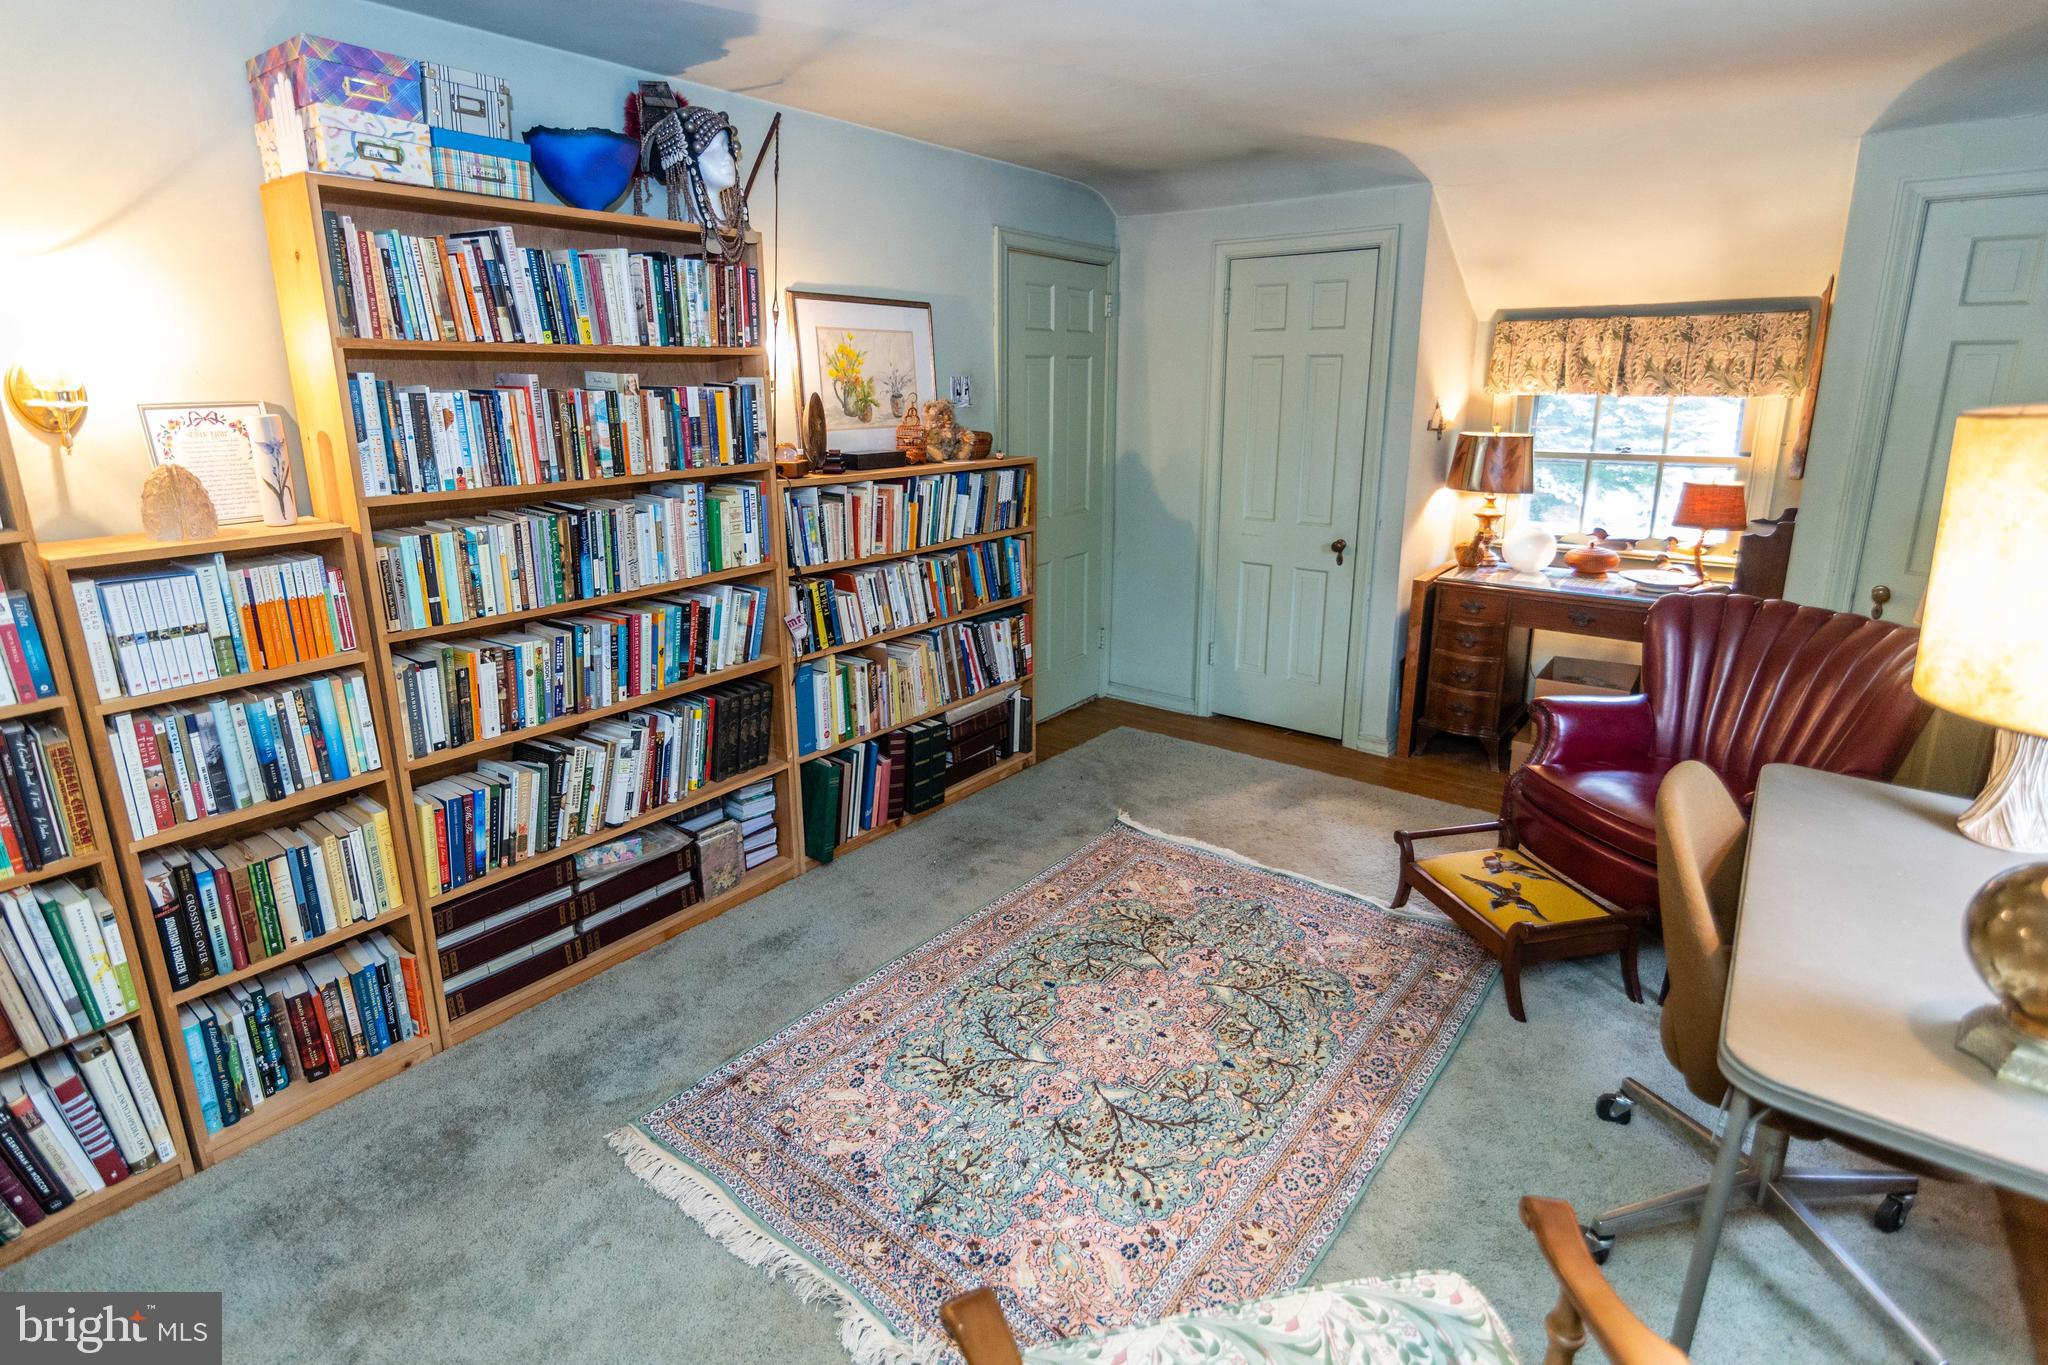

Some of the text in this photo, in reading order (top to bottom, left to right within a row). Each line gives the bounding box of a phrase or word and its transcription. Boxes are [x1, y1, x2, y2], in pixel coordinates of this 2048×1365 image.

[330, 219, 344, 281] DEAREST FRIEND
[504, 230, 518, 265] GEISHA,
[514, 275, 524, 294] LIFE
[529, 250, 539, 284] SHUTTERBABE
[362, 381, 378, 427] LOUISE
[631, 399, 640, 431] Benjamin
[359, 449, 367, 470] PAMELA
[487, 438, 495, 465] SONGLINES
[686, 488, 697, 527] 1861
[551, 531, 559, 550] Capture
[579, 516, 590, 554] Dreaming Water
[203, 572, 217, 596] JAMES
[396, 577, 406, 600] SOLOMON
[474, 580, 482, 606] PATCHETT
[13, 599, 30, 628] Tisha
[976, 627, 986, 654] HUMANS
[407, 677, 419, 720] ORCHARDIST
[137, 735, 149, 763] TRUTH
[146, 736, 157, 760] PLAIN
[171, 733, 180, 753] CRACE
[259, 723, 273, 758] MOUNTAIN
[177, 758, 185, 775] BEING
[56, 745, 93, 845] MICHAEL CHABON
[152, 793, 163, 818] PICOULT
[254, 864, 262, 881] Barbara
[185, 892, 209, 964] CROSSING OVER
[213, 924, 227, 957] SUSAN STRAIGHT
[164, 916, 186, 974] JONATHAN FRANZEN
[256, 995, 267, 1021] Celeste Ng
[322, 990, 335, 1018] HAMILTON
[329, 990, 336, 999] MY
[382, 983, 397, 1024] Freddie Mercury
[294, 997, 304, 1016] BENEATH
[301, 1020, 310, 1036] SCARLET
[366, 1020, 374, 1036] CALLED
[248, 1015, 263, 1053] CINEMATIC CANINES
[208, 1026, 224, 1073] Elizabeth Strout
[263, 1024, 281, 1077] Little Fires Everywhere
[224, 1097, 234, 1113] Again
[4, 1137, 29, 1165] GENTLEMAN
[24, 1164, 34, 1172] IN
[29, 1171, 50, 1195] MOSCOW
